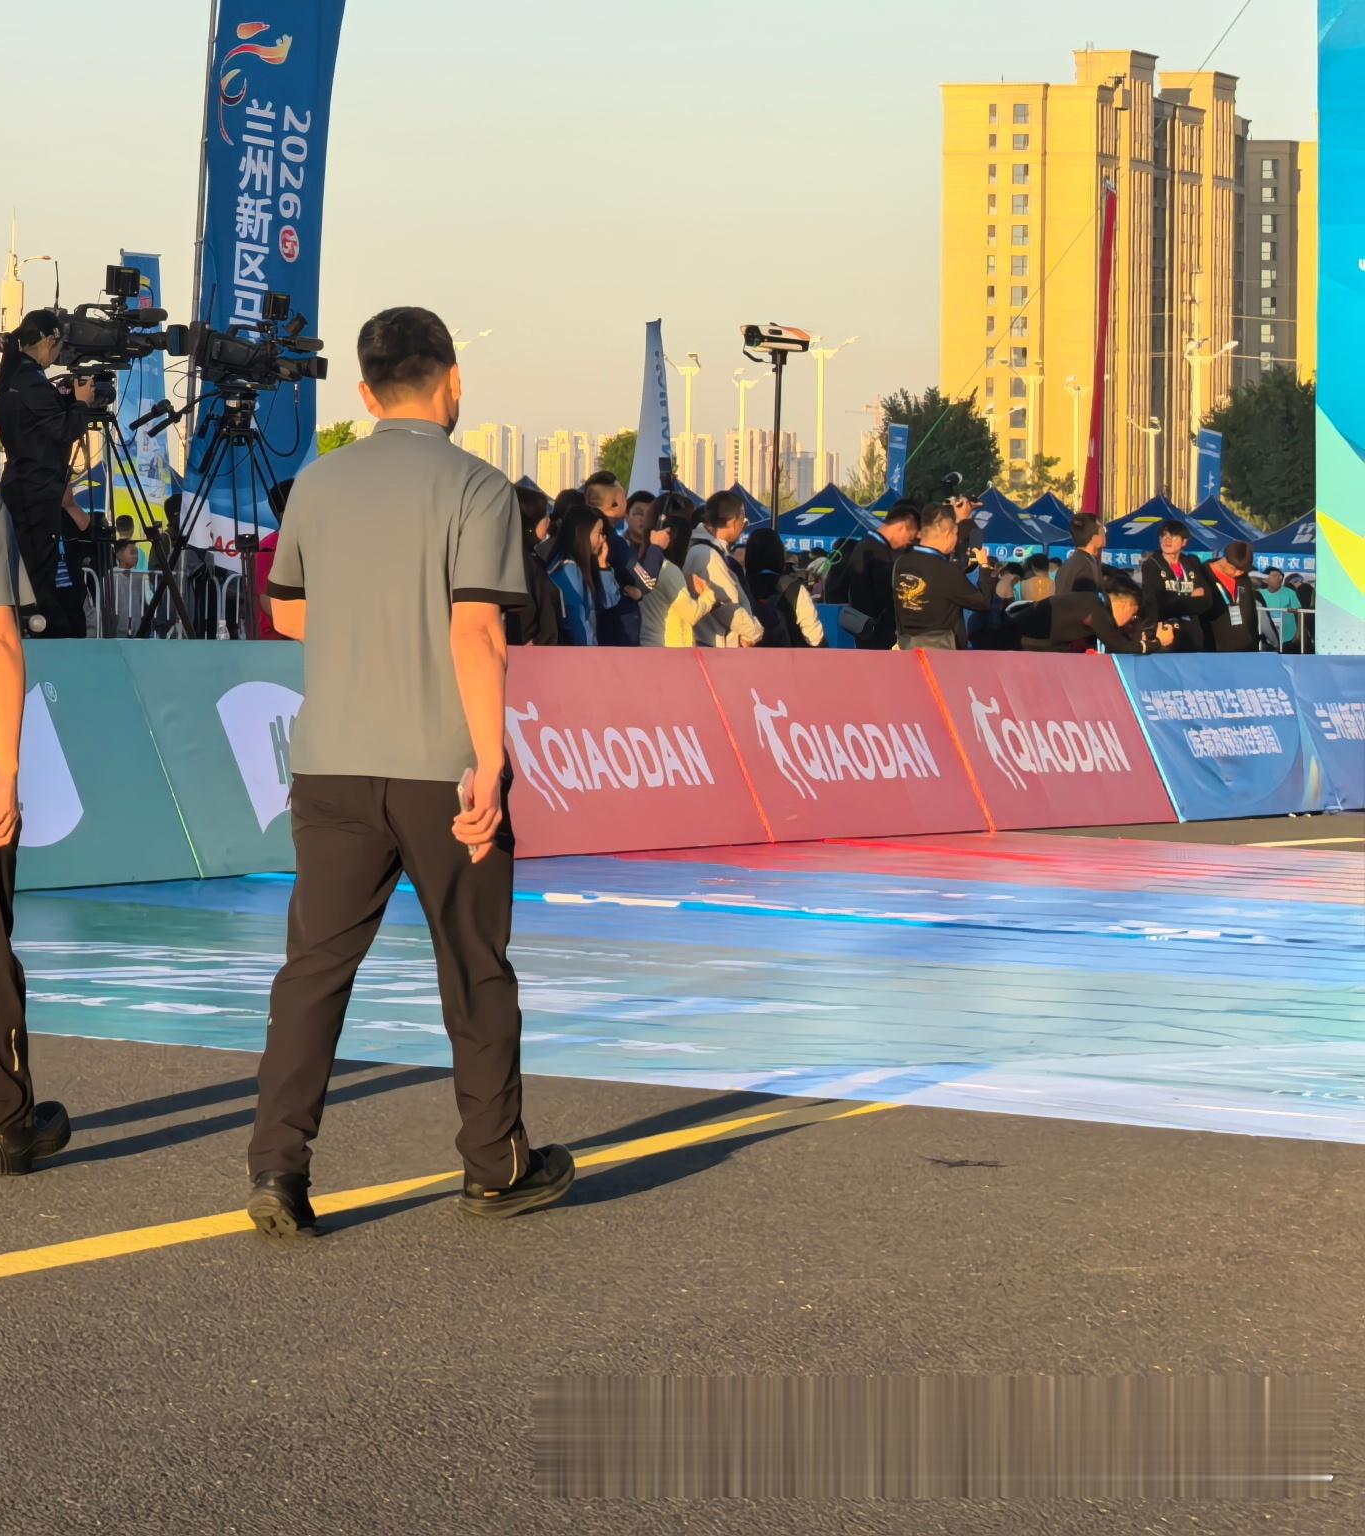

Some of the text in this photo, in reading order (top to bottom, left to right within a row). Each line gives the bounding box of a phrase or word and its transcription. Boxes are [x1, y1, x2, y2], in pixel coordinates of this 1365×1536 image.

[279, 105, 311, 220] 2026
[229, 99, 277, 345] 兰州新区马
[539, 725, 715, 791] QIAODAN
[789, 722, 940, 782] QIAODAN
[1000, 720, 1132, 773] QIAODAN
